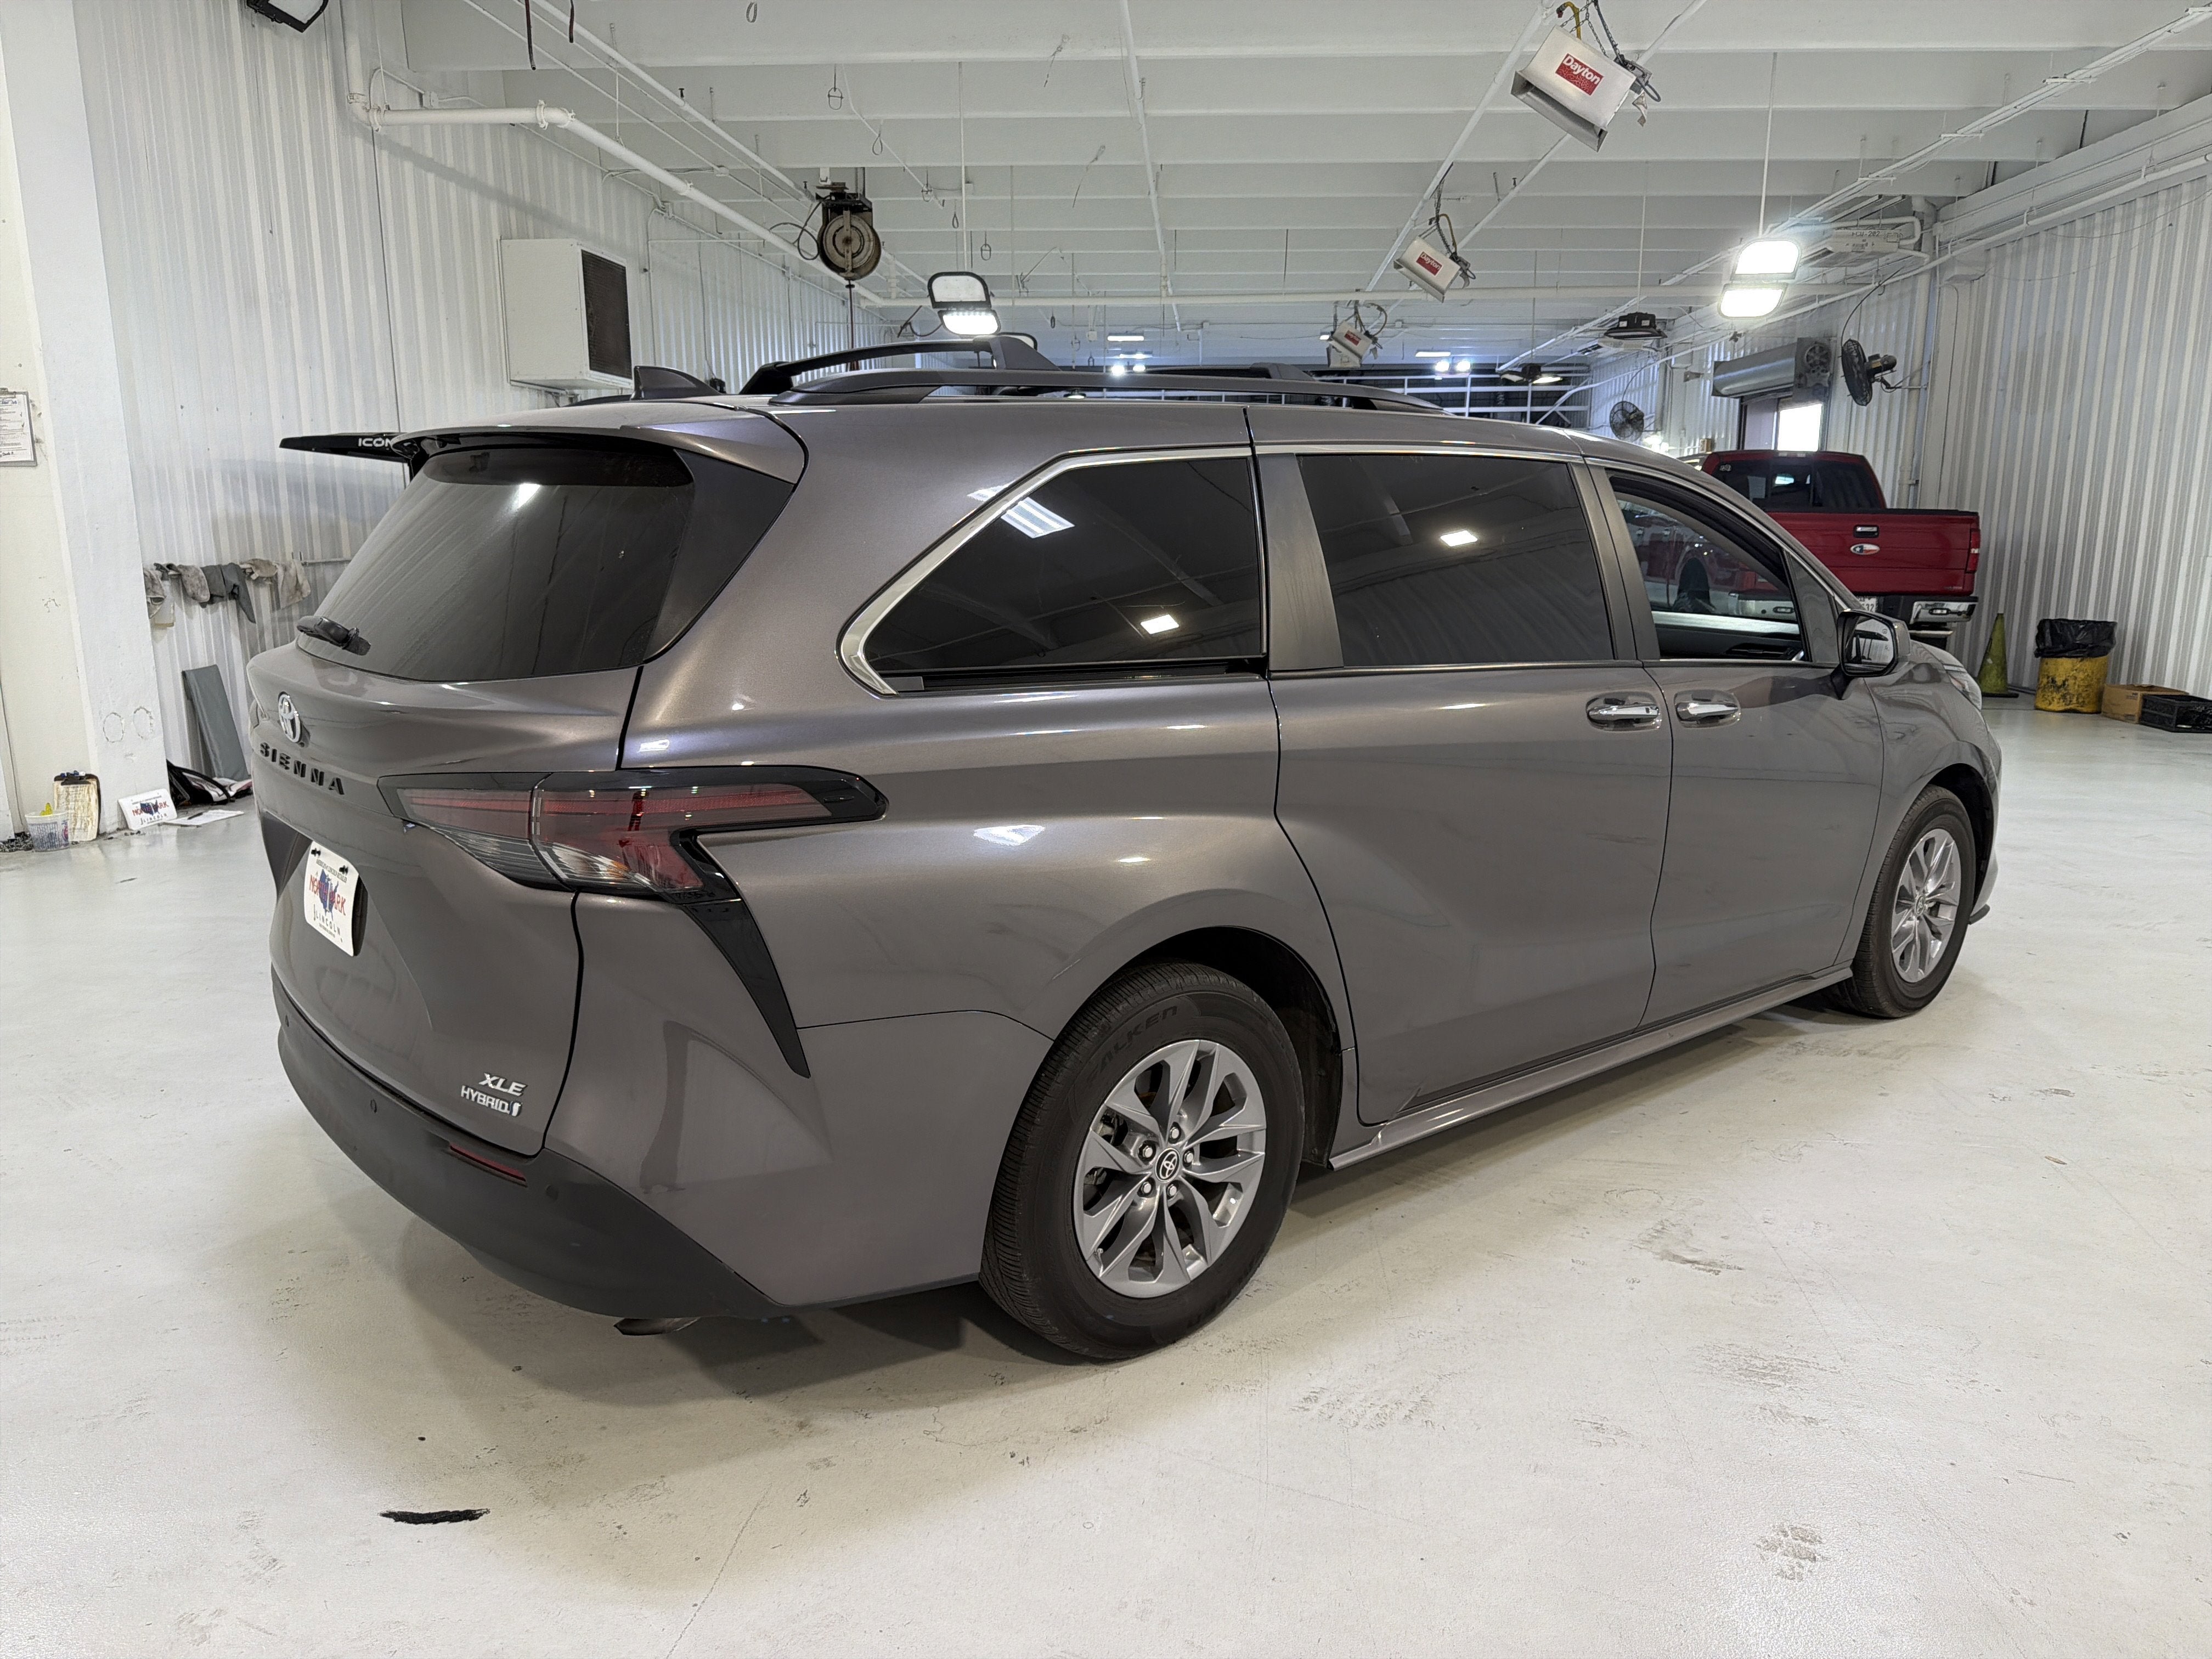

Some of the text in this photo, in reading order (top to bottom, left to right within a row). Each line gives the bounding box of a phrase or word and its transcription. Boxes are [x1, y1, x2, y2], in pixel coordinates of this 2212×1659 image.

[1562, 55, 1600, 84] Dayton
[1420, 253, 1441, 270] Dayton
[358, 437, 391, 447] ICON
[260, 742, 345, 795] SIENNA
[316, 911, 340, 935] LINCOLN
[478, 1073, 527, 1096] XLE
[461, 1085, 510, 1114] HYBRID
